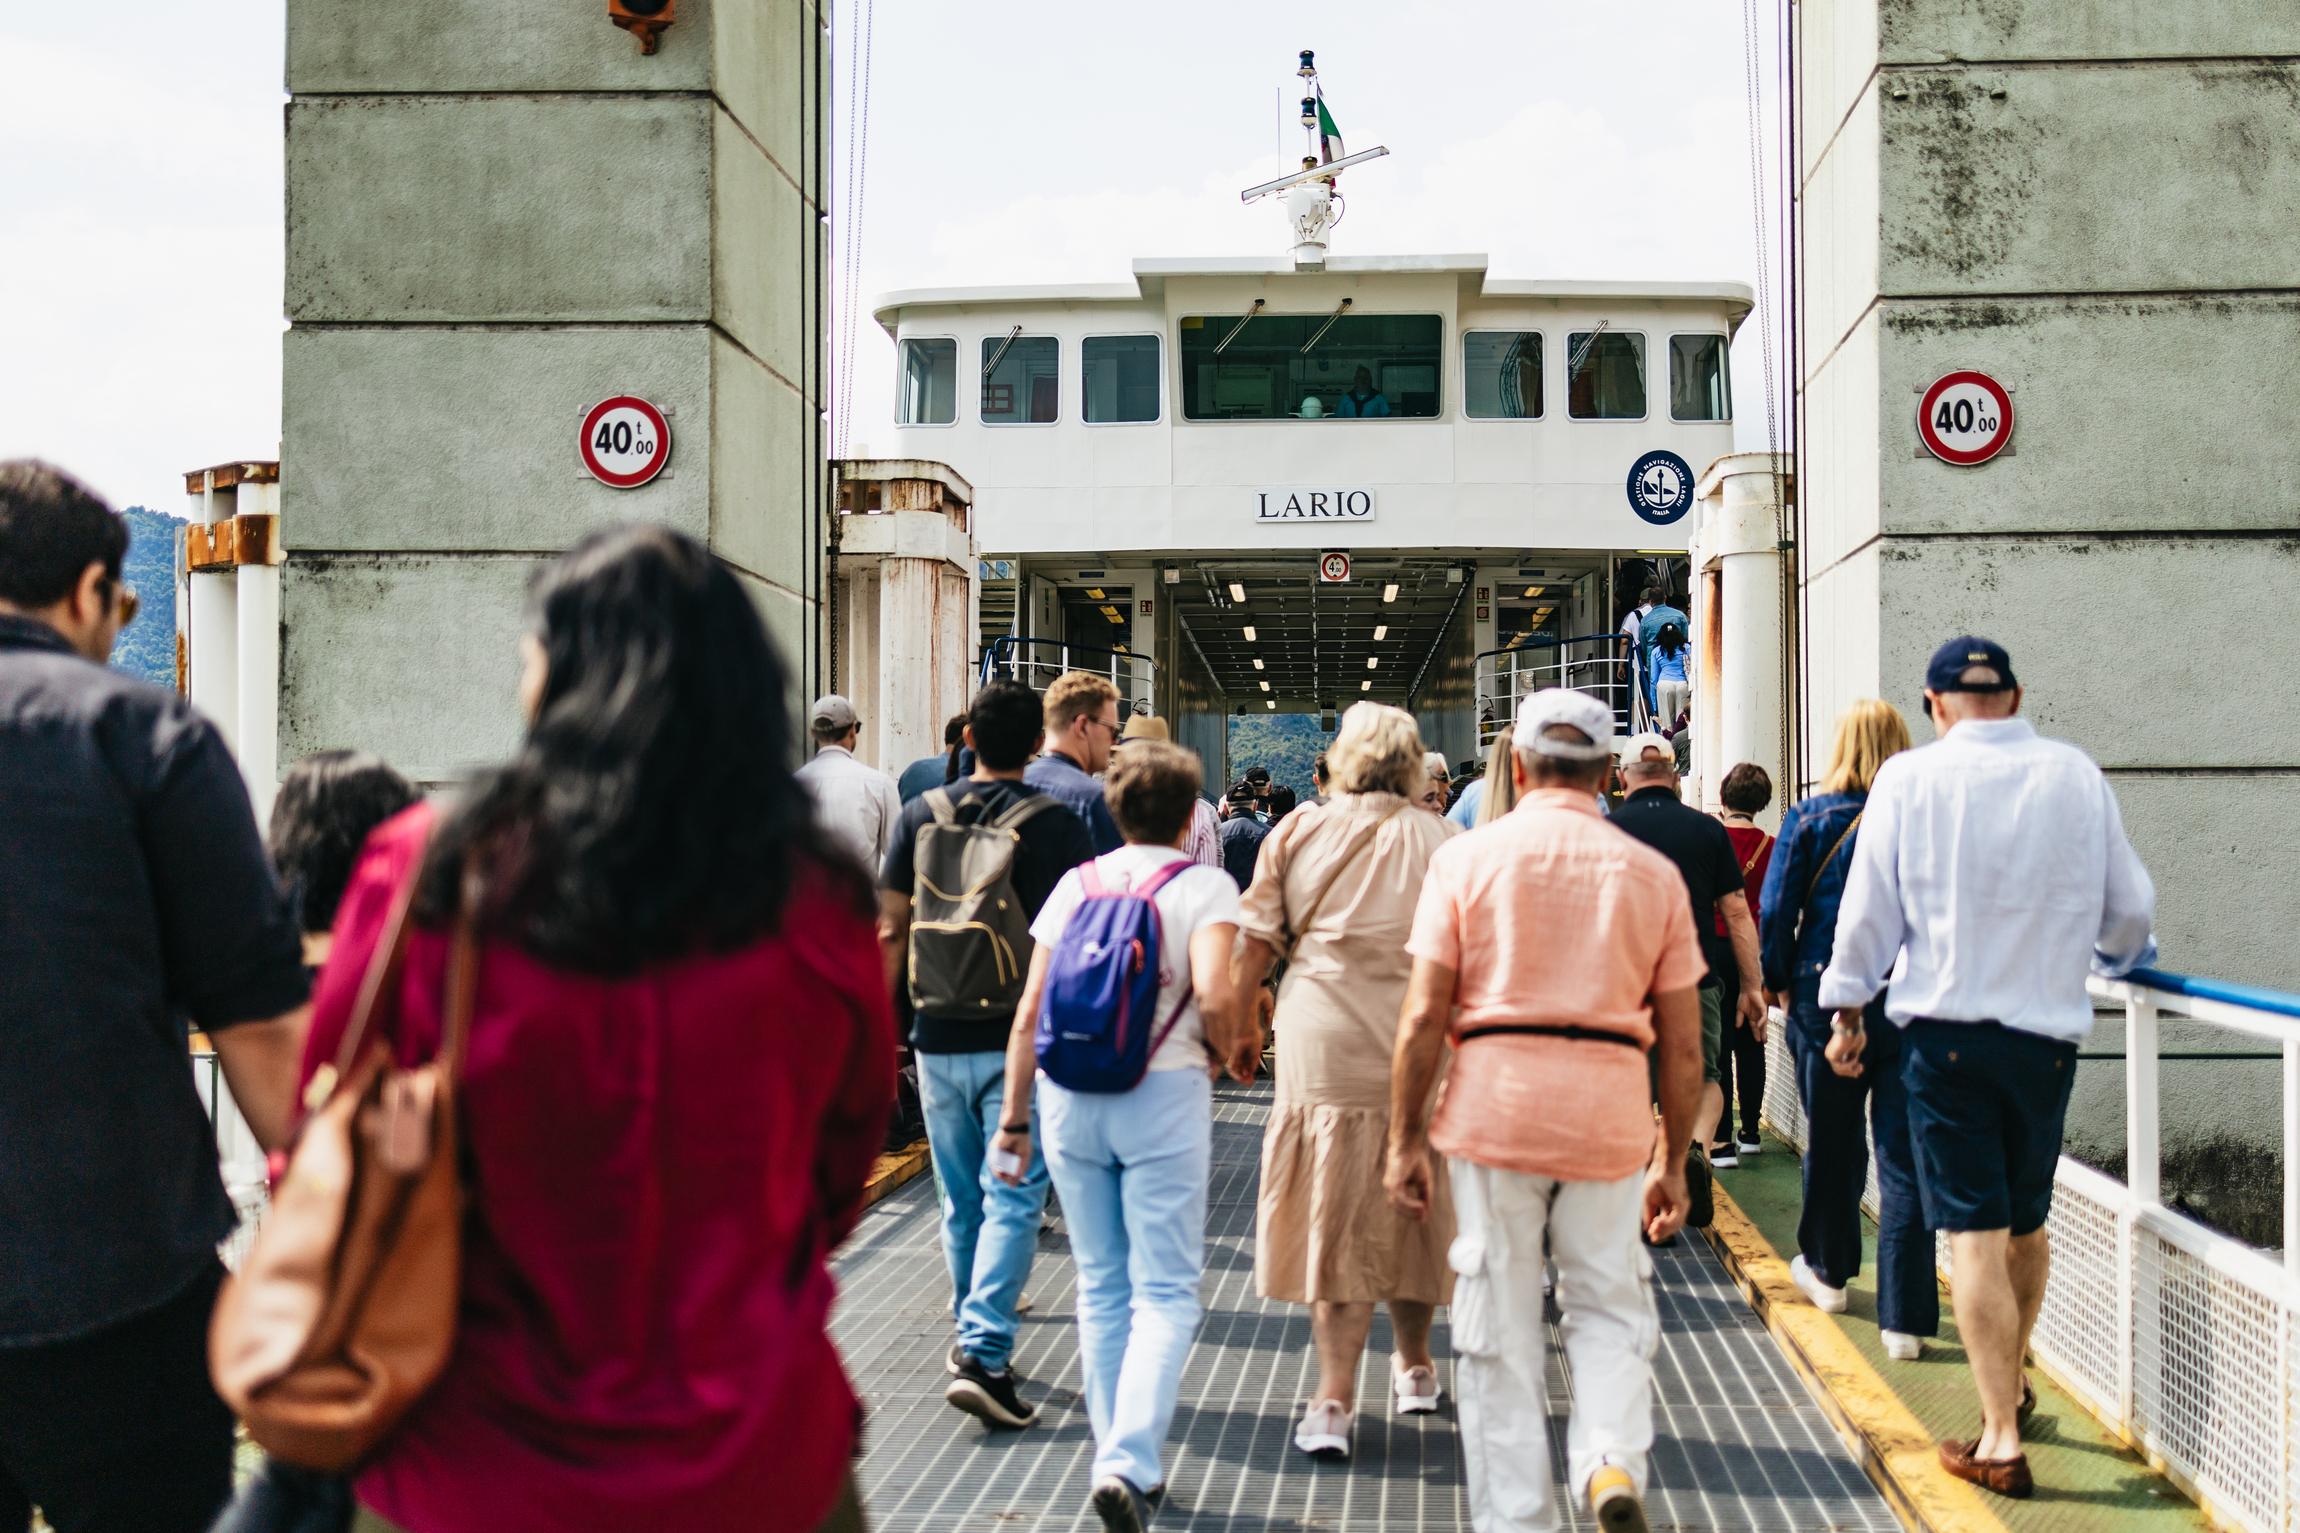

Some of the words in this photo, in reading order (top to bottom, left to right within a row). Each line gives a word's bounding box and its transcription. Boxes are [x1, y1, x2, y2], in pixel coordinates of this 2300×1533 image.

[1643, 459, 1686, 482] NAVIGAZIONE
[1676, 485, 1687, 507] LAGHI
[1258, 490, 1371, 518] LARIO
